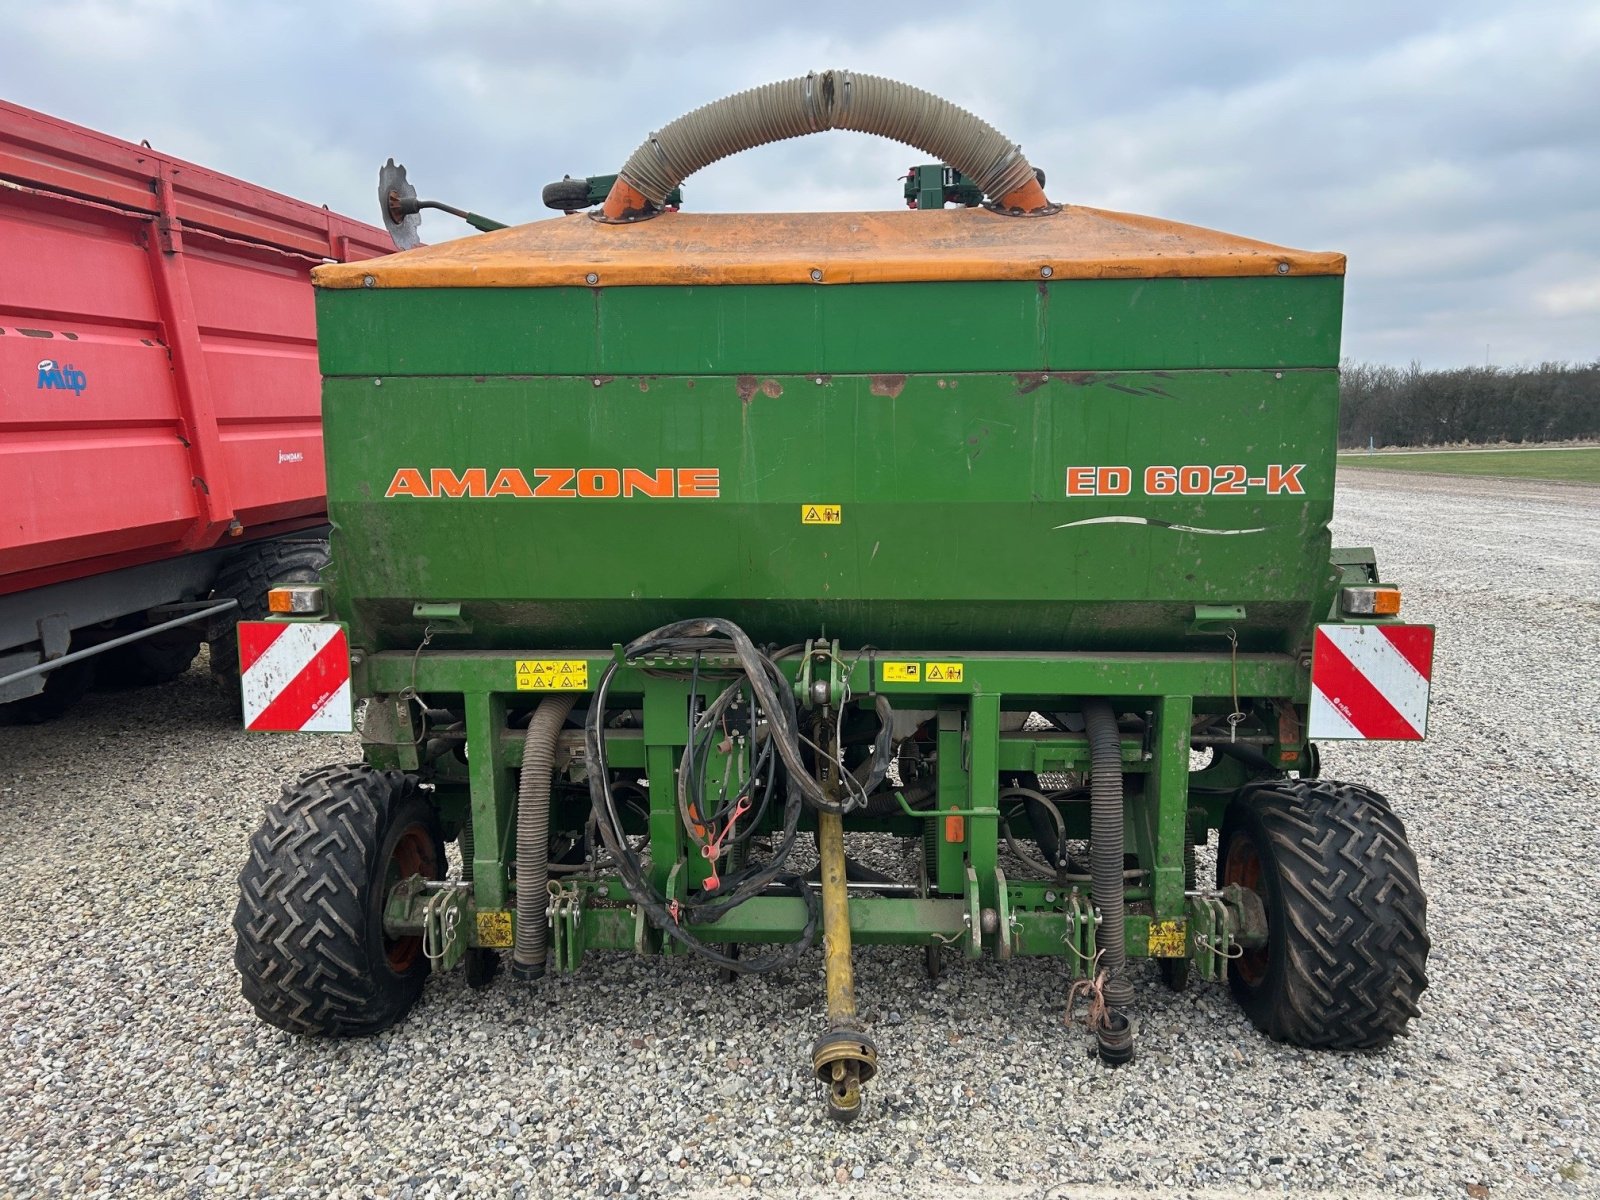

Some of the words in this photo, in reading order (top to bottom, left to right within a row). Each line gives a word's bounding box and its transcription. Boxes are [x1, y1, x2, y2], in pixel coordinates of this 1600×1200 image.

[384, 468, 720, 498] AMAZONE
[1066, 466, 1132, 497] ED
[1144, 464, 1307, 495] 602-K
